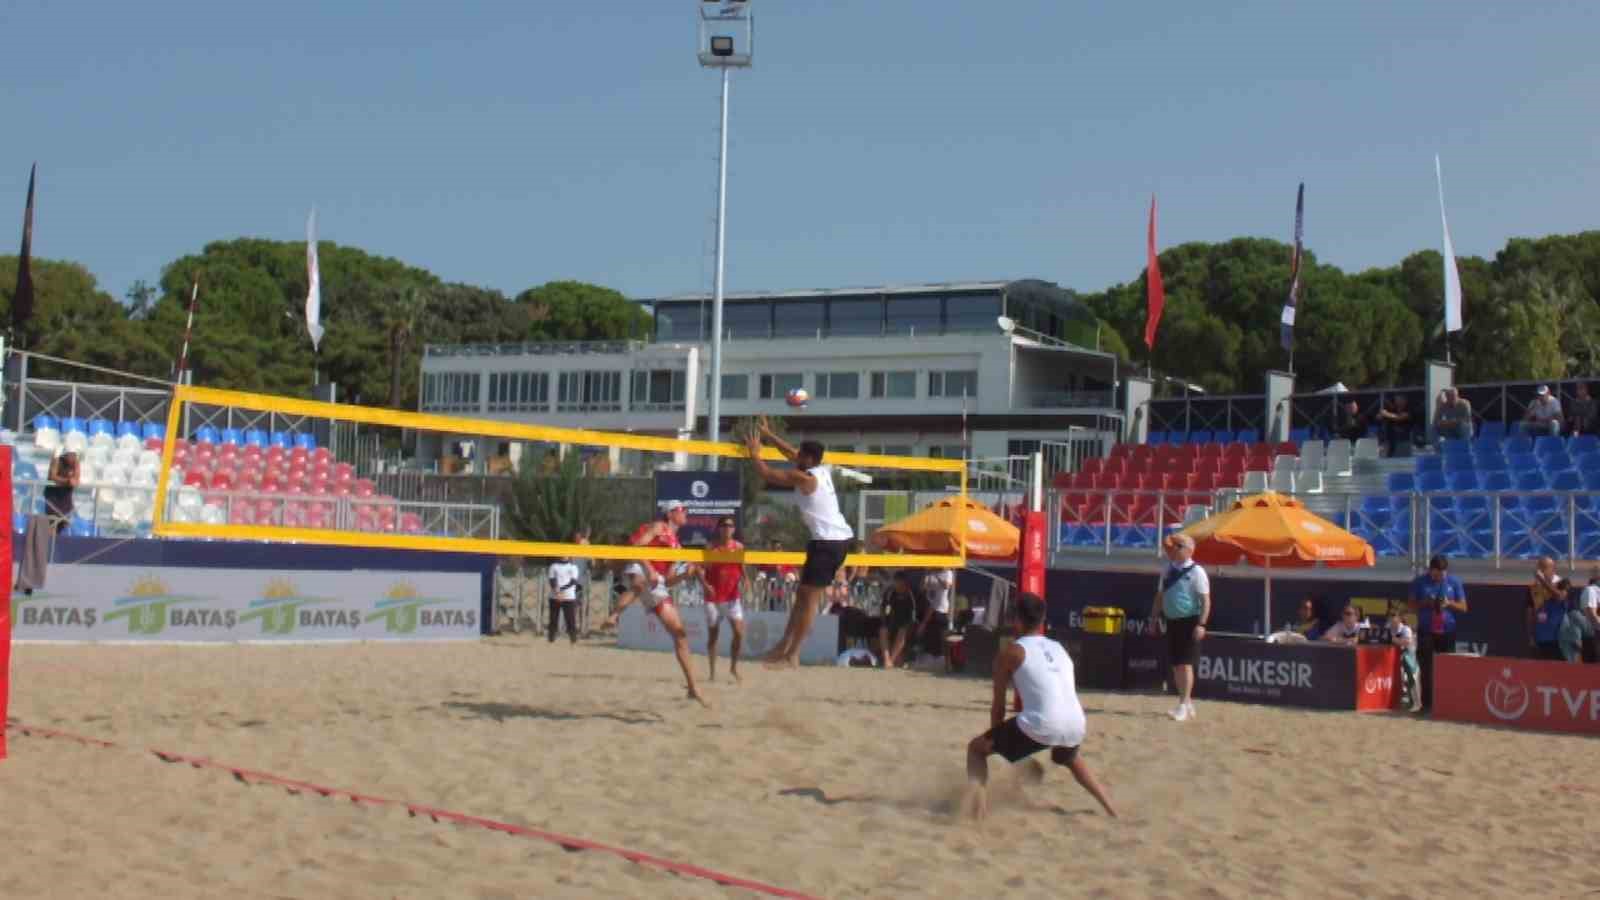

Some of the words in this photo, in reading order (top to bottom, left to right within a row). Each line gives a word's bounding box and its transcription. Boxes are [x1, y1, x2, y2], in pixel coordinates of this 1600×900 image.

[22, 606, 96, 629] BATAŞ
[170, 608, 239, 630] BATAŞ
[301, 609, 361, 629] BATAŞ
